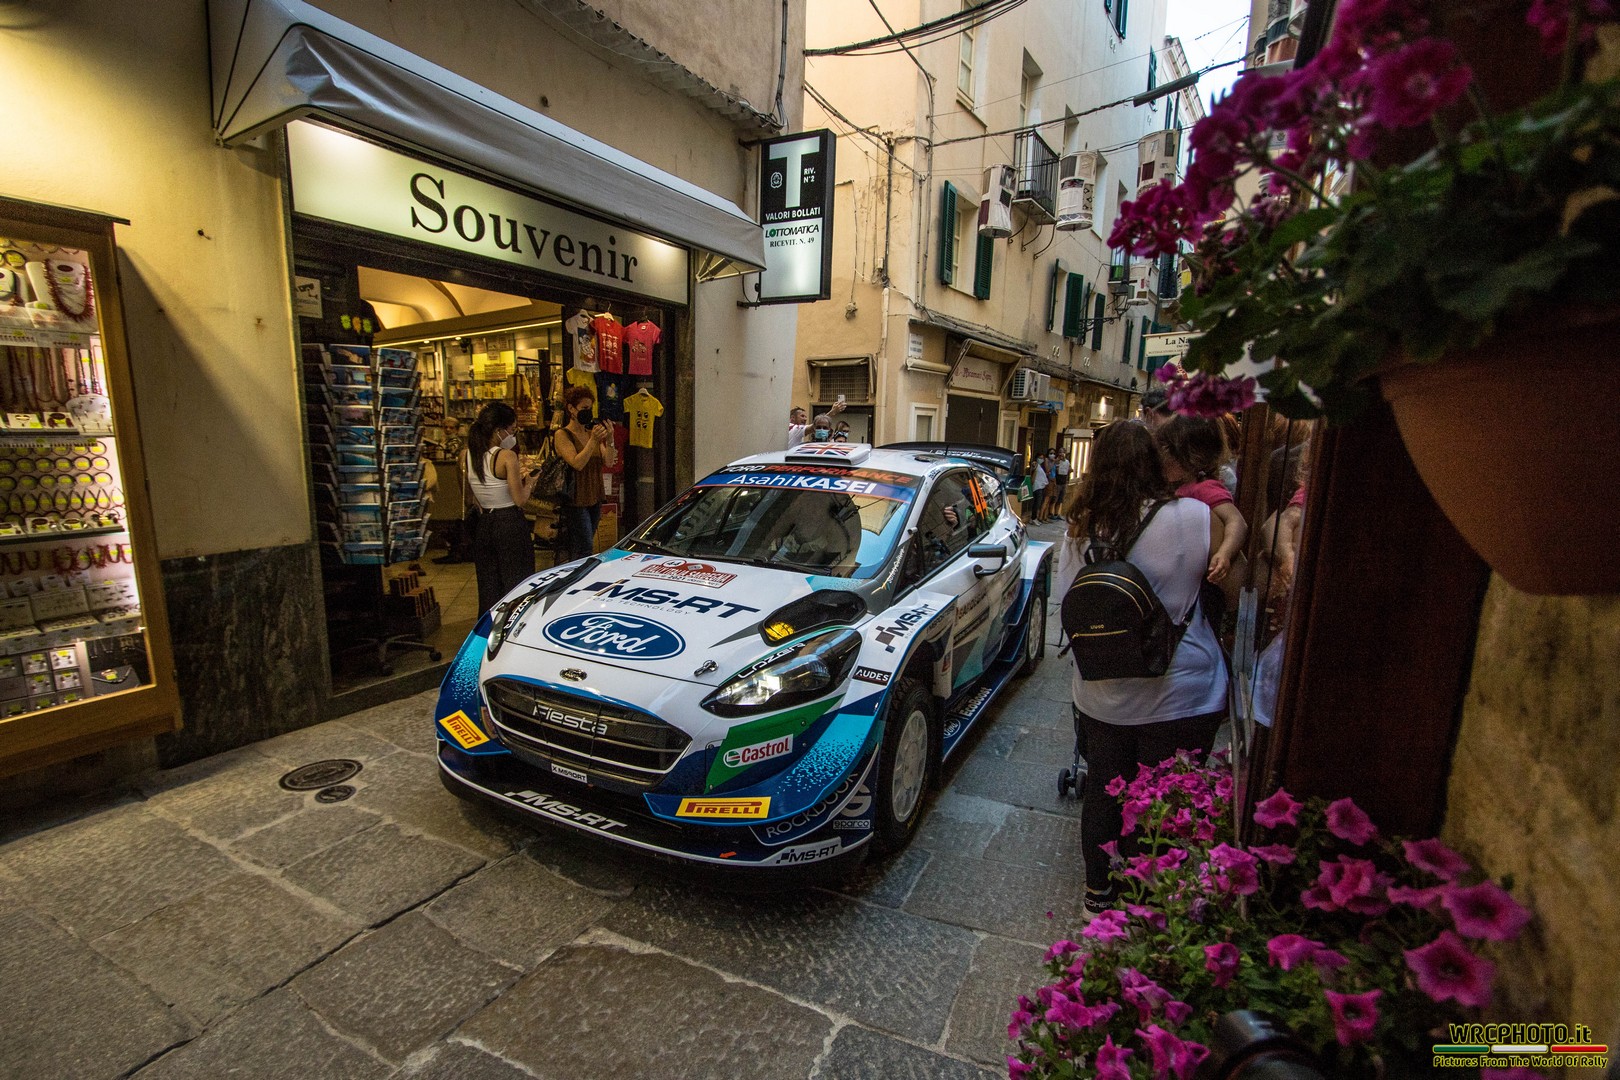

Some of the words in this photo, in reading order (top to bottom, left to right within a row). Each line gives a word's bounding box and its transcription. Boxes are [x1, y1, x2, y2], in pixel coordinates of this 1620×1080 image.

[769, 136, 820, 208] T
[803, 167, 816, 175] RIV.
[765, 211, 790, 221] VALORI
[791, 207, 821, 218] BOLLATI
[410, 173, 638, 283] Souvenir
[765, 224, 820, 238] LOTTOMATICA
[769, 239, 798, 248] RICEVIT.
[1165, 338, 1176, 346] La
[720, 465, 765, 474] FORD
[764, 465, 913, 483] PERFORMANCE
[618, 600, 692, 615] TECHNOLOGY
[560, 616, 661, 653] Ford
[856, 668, 890, 682] AUDES
[532, 704, 608, 735] Fiesta
[446, 715, 482, 745] PIRELLI
[741, 737, 790, 763] Castrol
[685, 801, 763, 815] PIRELLI
[834, 820, 870, 829] sparco
[788, 844, 839, 863] MS-RT
